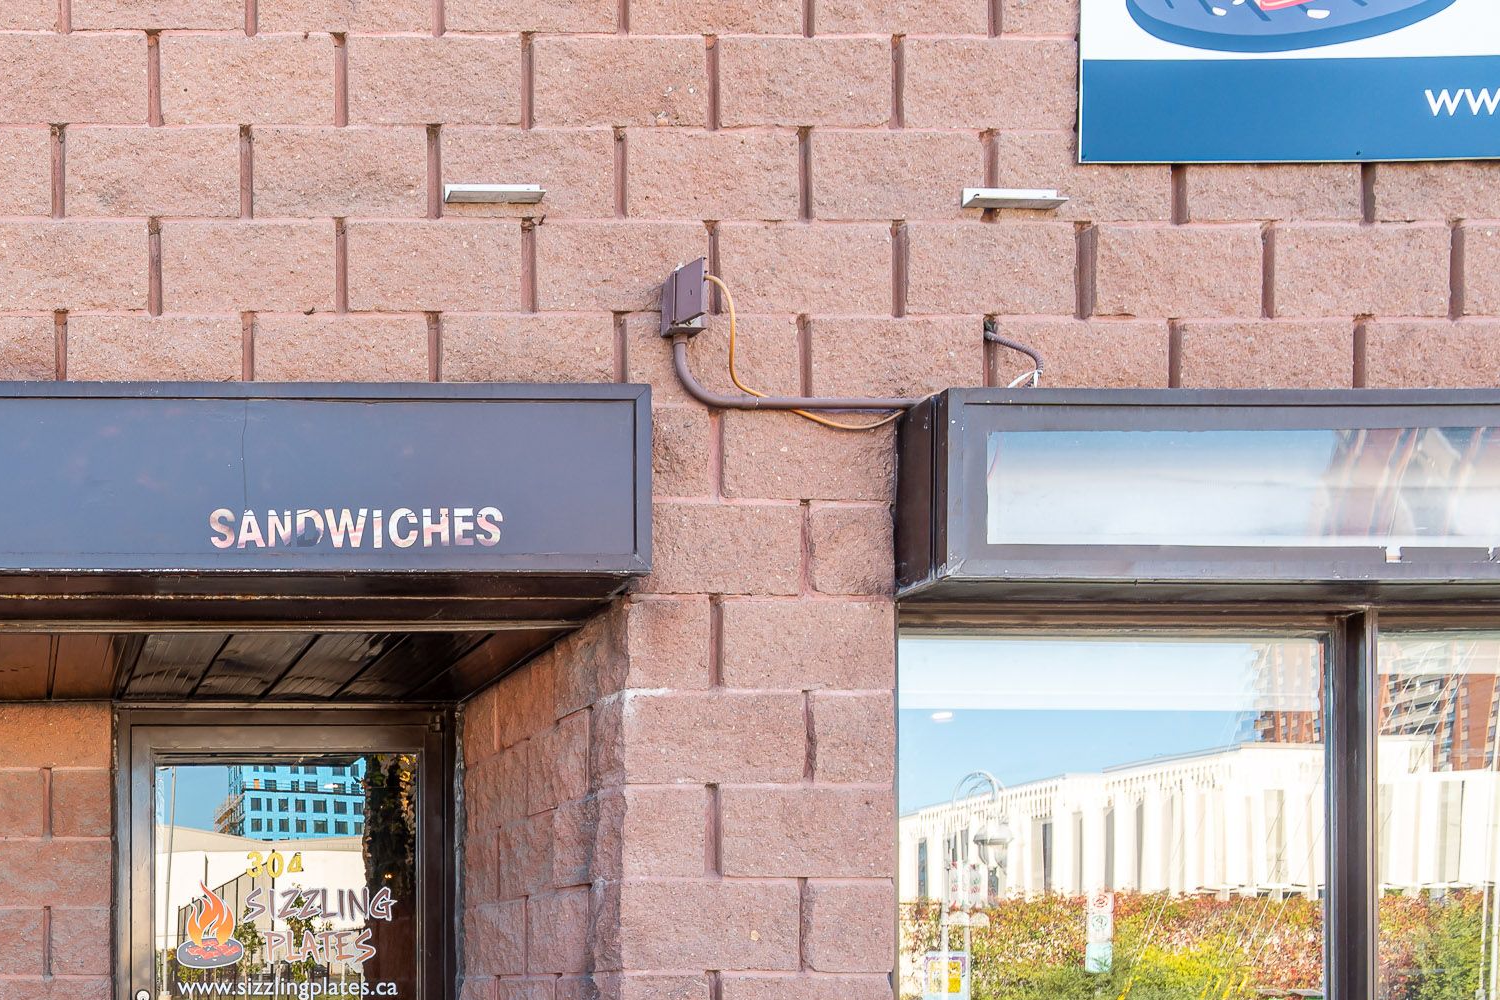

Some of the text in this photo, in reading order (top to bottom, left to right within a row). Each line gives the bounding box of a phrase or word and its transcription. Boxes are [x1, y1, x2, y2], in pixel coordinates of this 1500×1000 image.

[208, 506, 504, 549] SANDWICHES
[246, 851, 304, 878] 304
[244, 887, 398, 922] SIZZLING
[263, 928, 376, 964] PLATES
[178, 976, 398, 1000] www.sizzlingplates.ca
